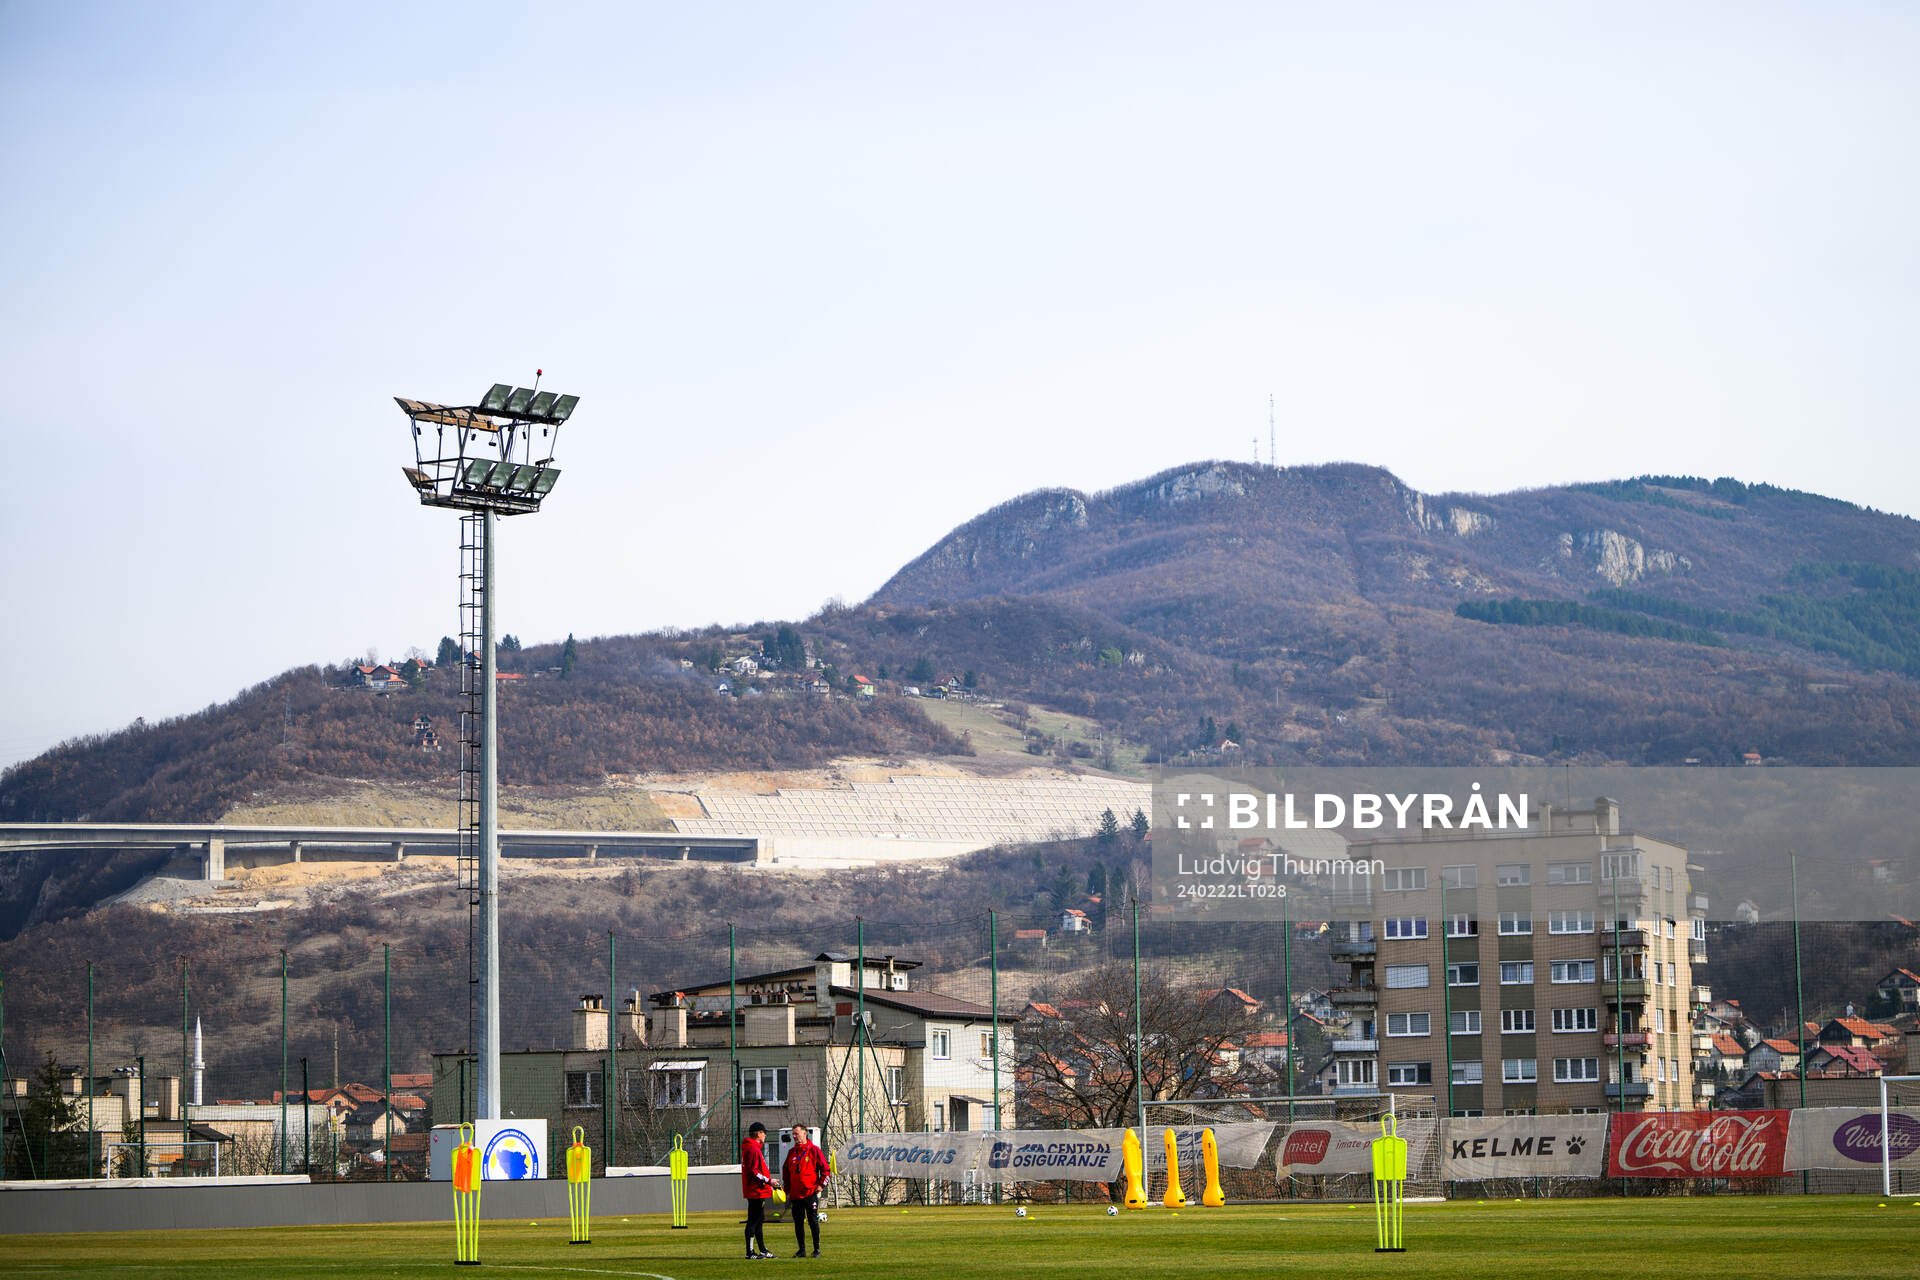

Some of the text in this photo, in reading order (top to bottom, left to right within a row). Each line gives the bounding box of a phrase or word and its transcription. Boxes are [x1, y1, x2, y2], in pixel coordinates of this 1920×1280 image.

[1287, 1140, 1323, 1154] m:tel
[1618, 1115, 1776, 1172] Coca-Cola
[1845, 1124, 1911, 1148] Violta
[847, 1142, 957, 1165] Centrotrans
[1047, 1143, 1111, 1154] CENTRAL
[1452, 1136, 1556, 1160] KELME
[1013, 1154, 1109, 1168] OSIGURANJE
